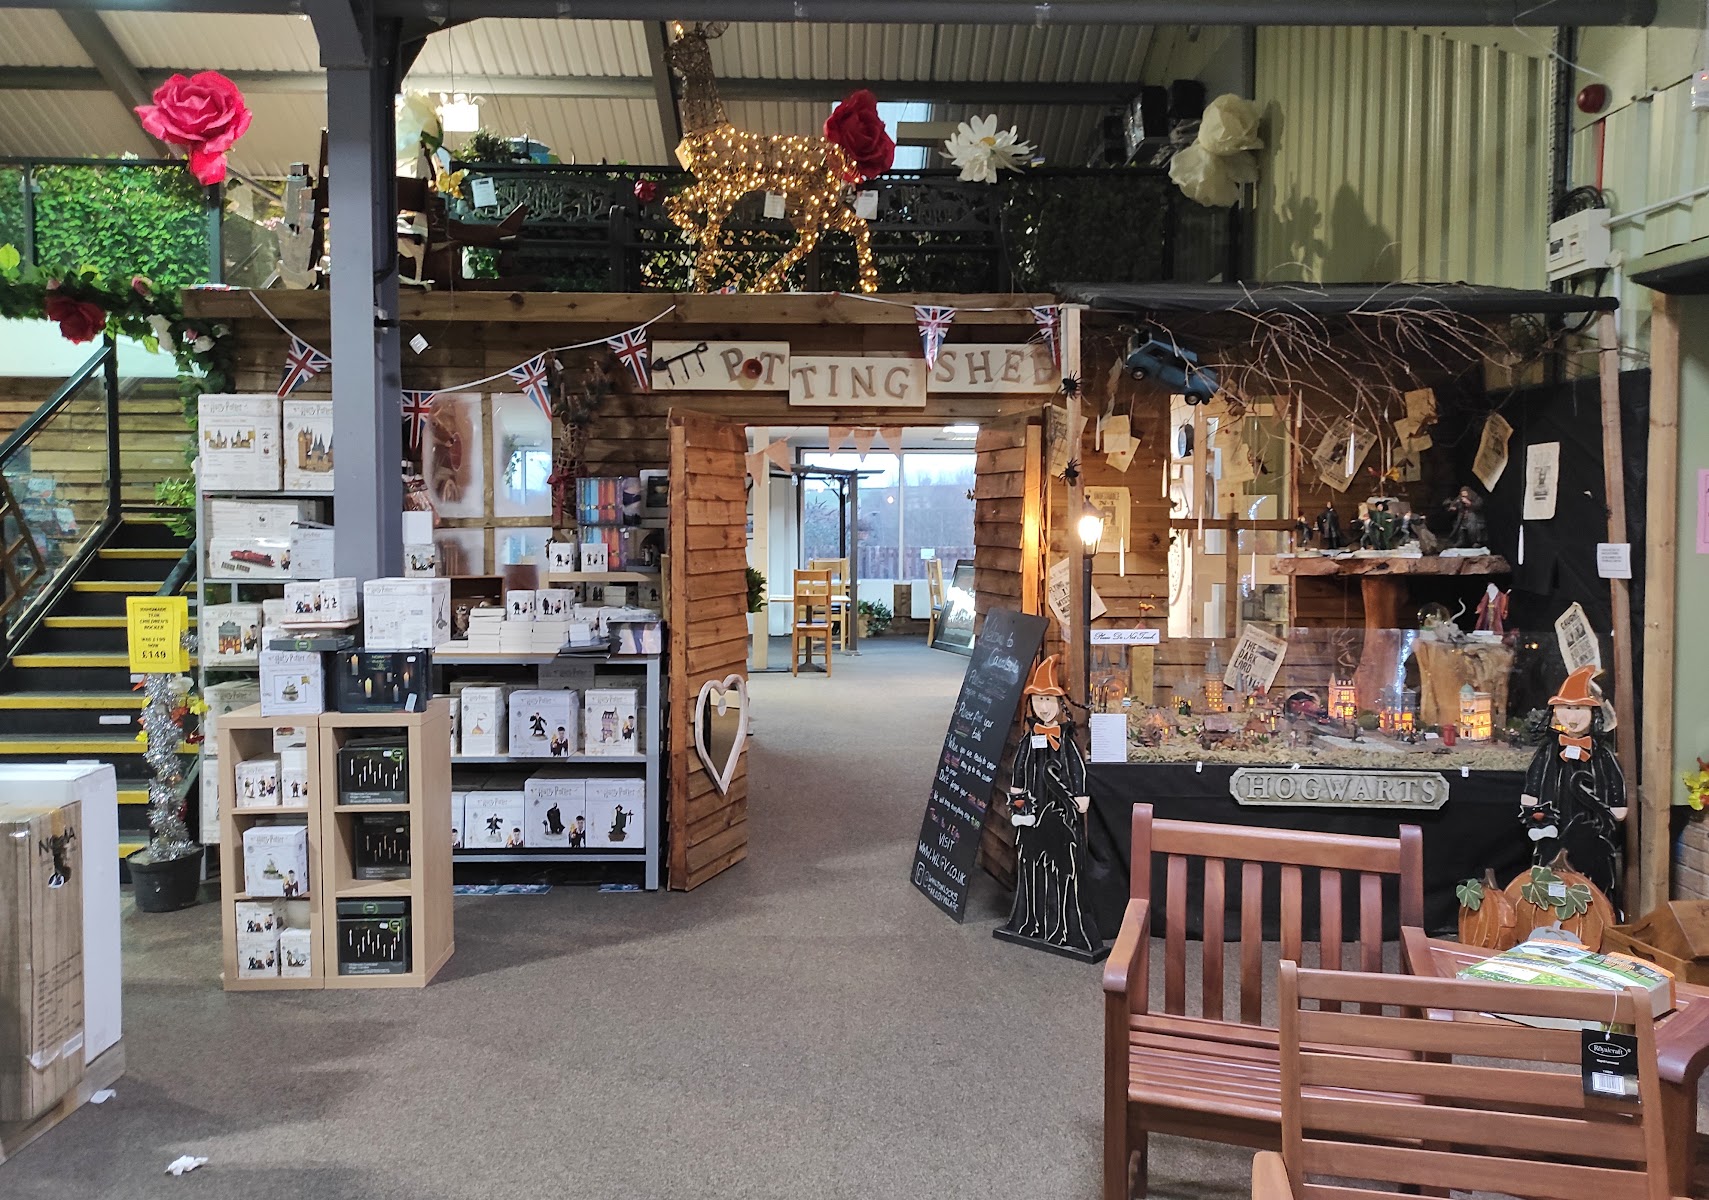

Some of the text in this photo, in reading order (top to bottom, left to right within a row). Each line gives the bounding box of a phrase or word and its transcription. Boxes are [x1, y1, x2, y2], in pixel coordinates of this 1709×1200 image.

[935, 348, 1057, 387] SHED
[1093, 631, 1157, 641] Please Do Not Touch
[1243, 640, 1258, 653] THE
[142, 651, 167, 659] £149
[1238, 648, 1260, 666] DARK
[1233, 658, 1253, 673] LORD
[539, 786, 573, 798] Harry Potter
[603, 786, 635, 798] Harry Potter
[1247, 774, 1436, 804] HOGWARTS
[938, 832, 955, 852] VISIT
[1594, 1044, 1624, 1056] Royalcraft
